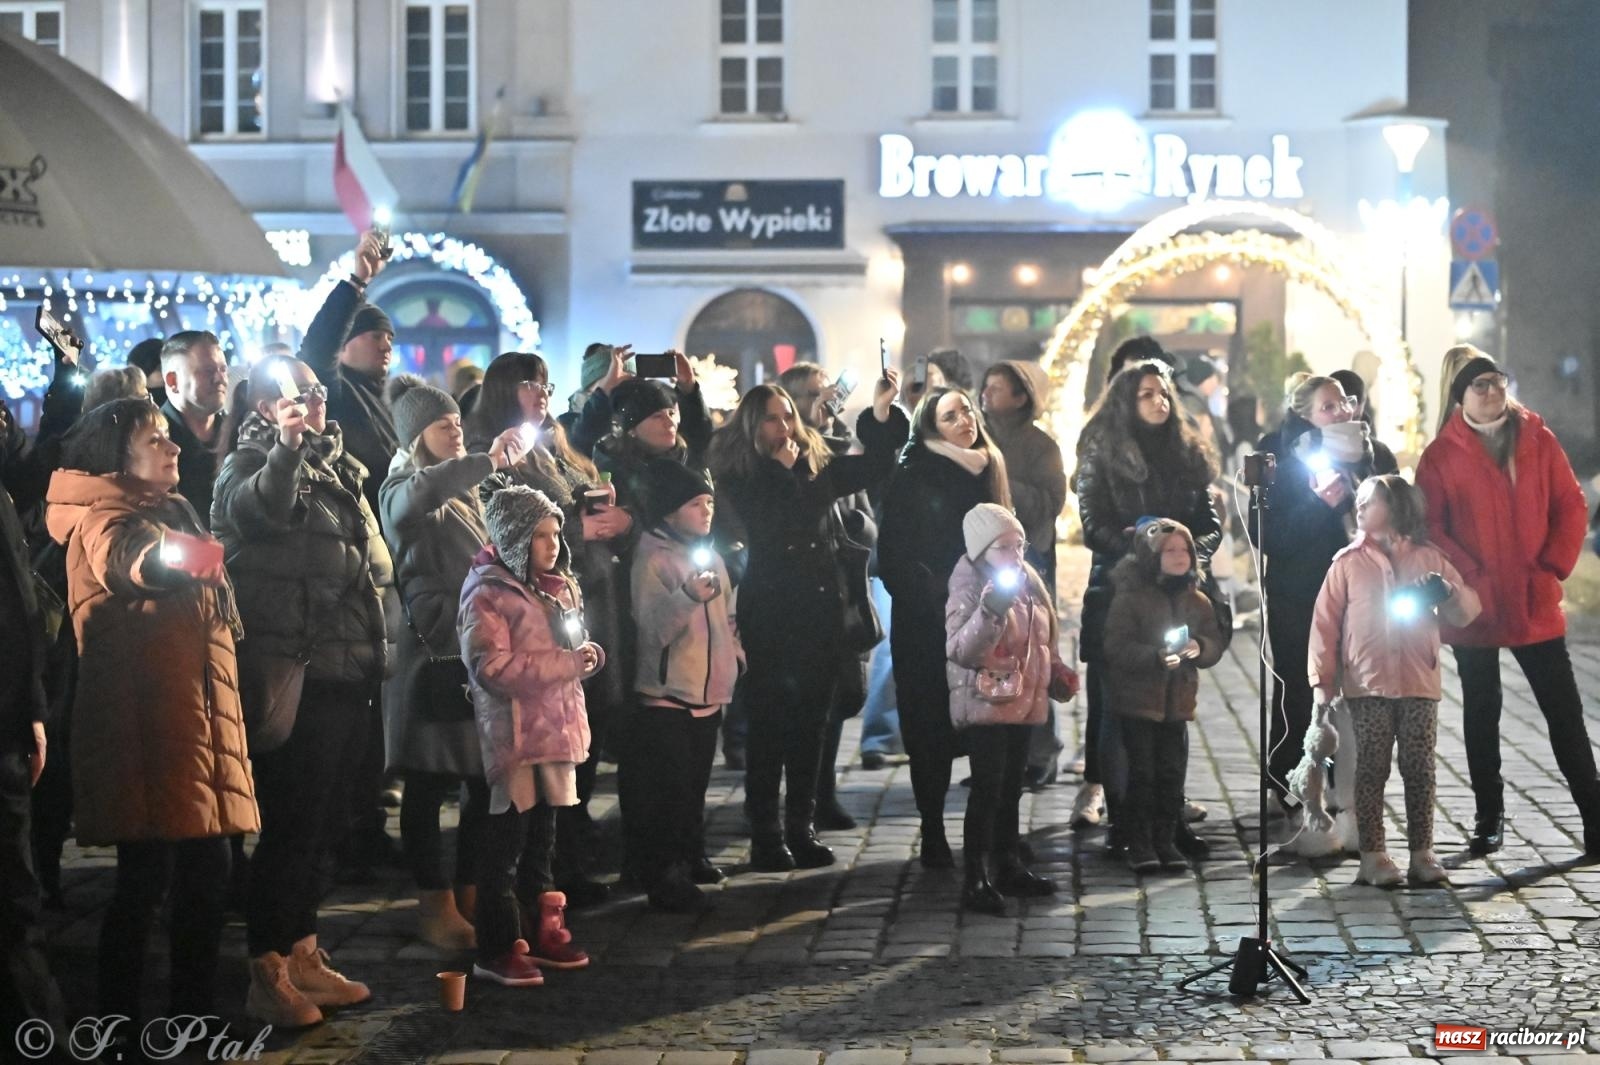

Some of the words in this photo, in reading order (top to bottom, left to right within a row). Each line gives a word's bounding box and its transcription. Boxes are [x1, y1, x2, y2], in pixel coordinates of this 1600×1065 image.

[879, 133, 1049, 198] Browar
[1152, 133, 1304, 205] Rynek
[643, 204, 713, 233] Złote
[718, 204, 832, 240] Wypieki
